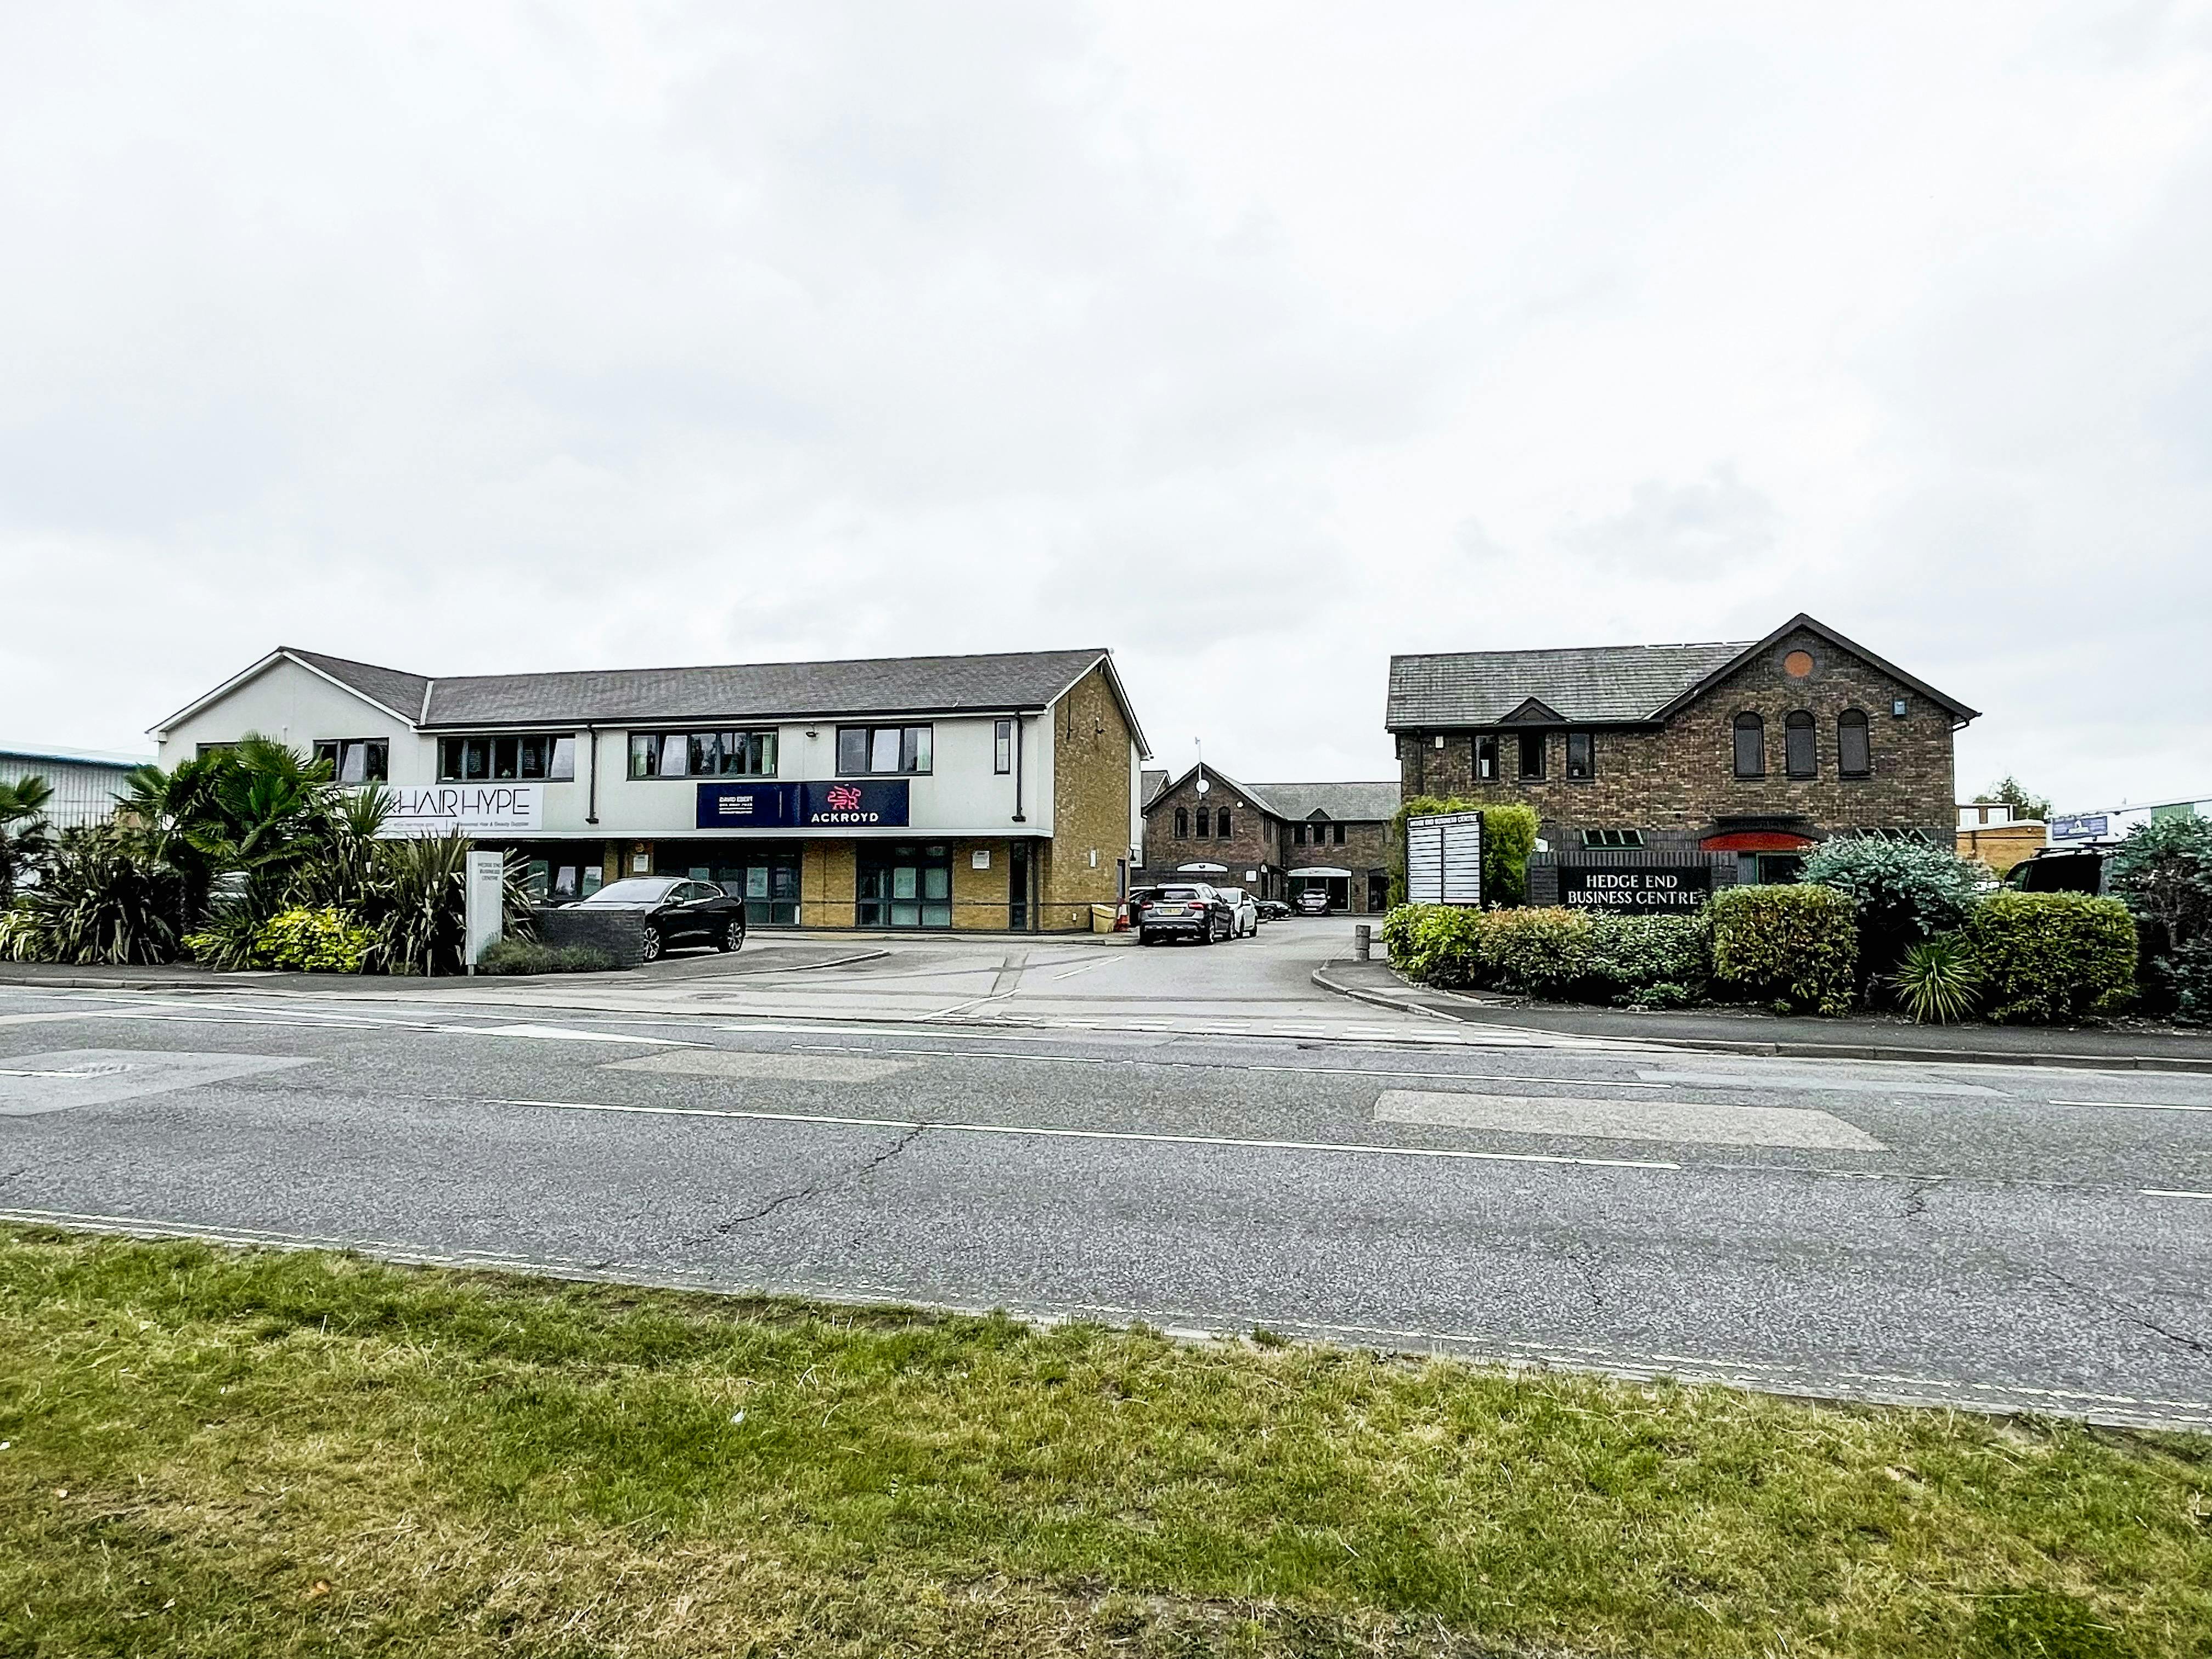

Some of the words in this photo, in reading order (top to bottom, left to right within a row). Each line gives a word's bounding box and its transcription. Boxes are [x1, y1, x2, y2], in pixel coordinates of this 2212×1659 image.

[811, 812, 879, 822] ACKROYD
[1586, 874, 1639, 888] HEDGE
[1645, 874, 1678, 888] END
[1568, 891, 1632, 905] BUSINESS
[1636, 891, 1699, 905] CENTRE
